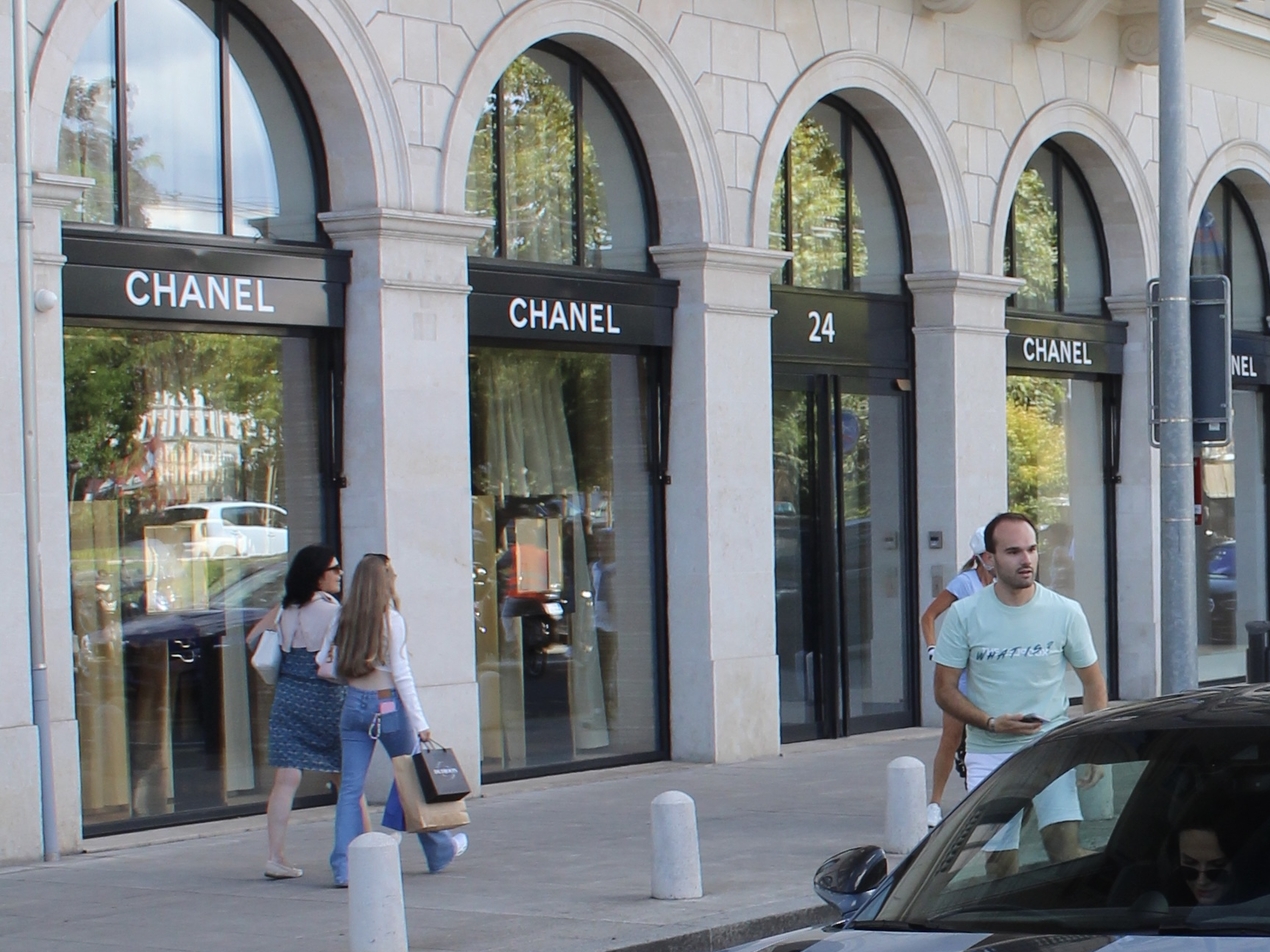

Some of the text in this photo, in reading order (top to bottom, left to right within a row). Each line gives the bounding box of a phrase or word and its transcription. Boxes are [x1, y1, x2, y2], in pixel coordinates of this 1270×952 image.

[125, 270, 274, 313] CHANEL
[509, 297, 621, 334] CHANEL
[808, 311, 835, 344] 24
[1022, 337, 1092, 365] CHANEL
[1231, 354, 1258, 377] NEL
[976, 646, 1021, 661] WHAT
